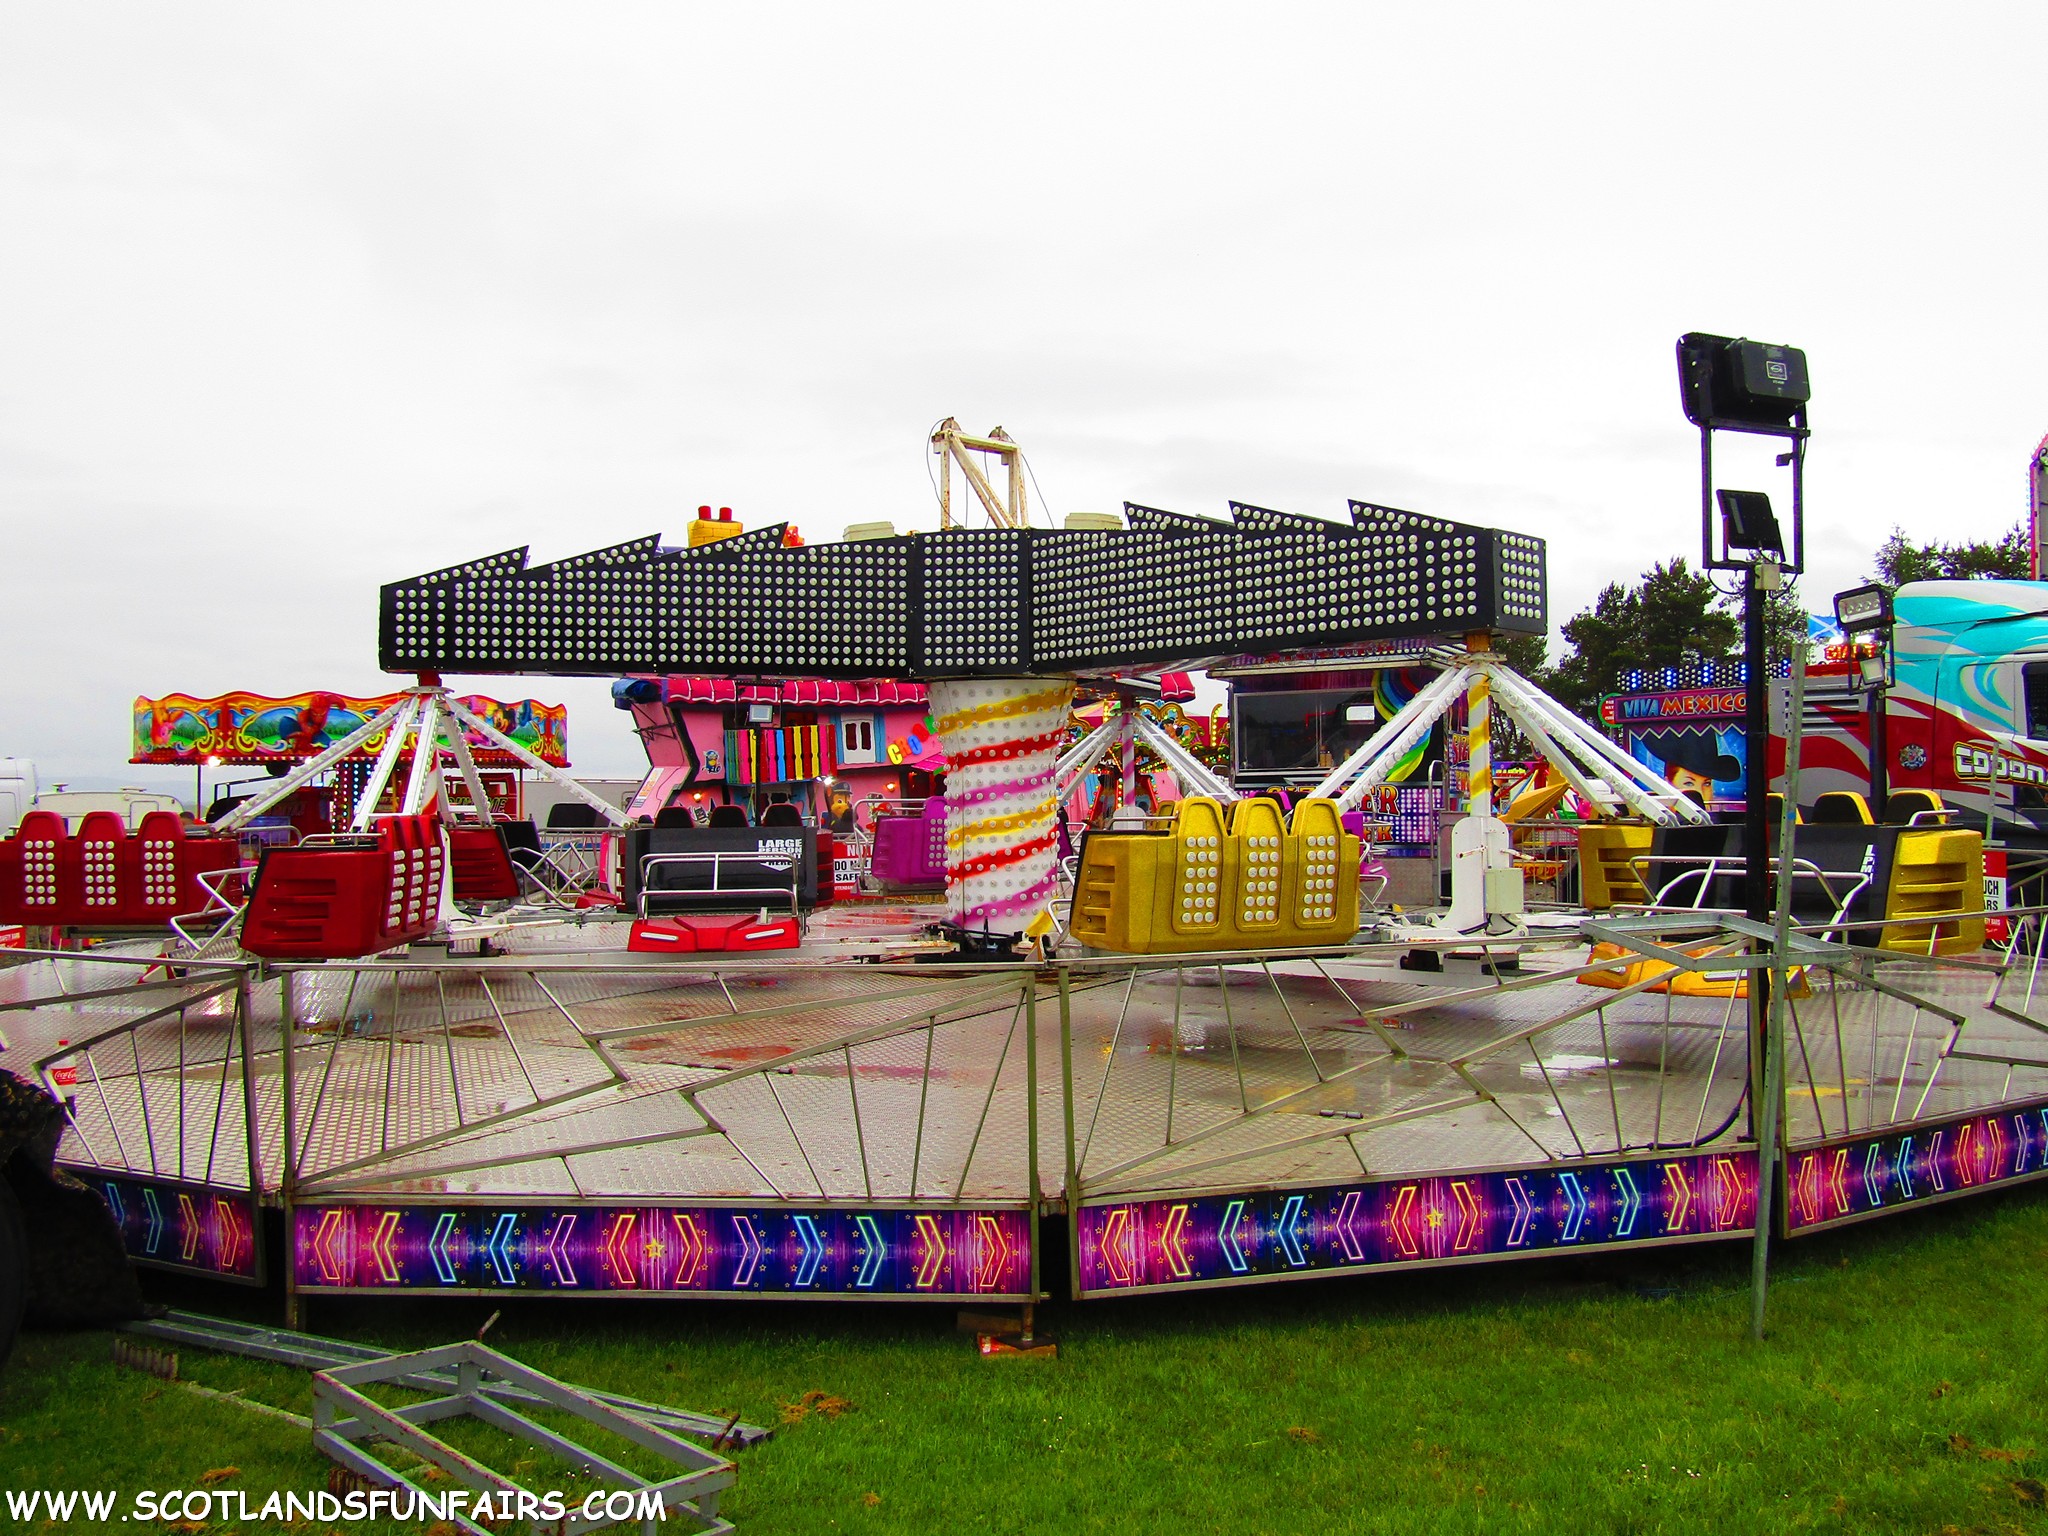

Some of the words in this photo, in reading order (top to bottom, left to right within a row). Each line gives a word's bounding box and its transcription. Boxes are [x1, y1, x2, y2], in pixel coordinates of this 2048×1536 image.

[1623, 697, 1659, 718] VIVA
[1659, 692, 1747, 717] MEXICO
[758, 838, 803, 848] LARGE
[834, 860, 847, 871] DO
